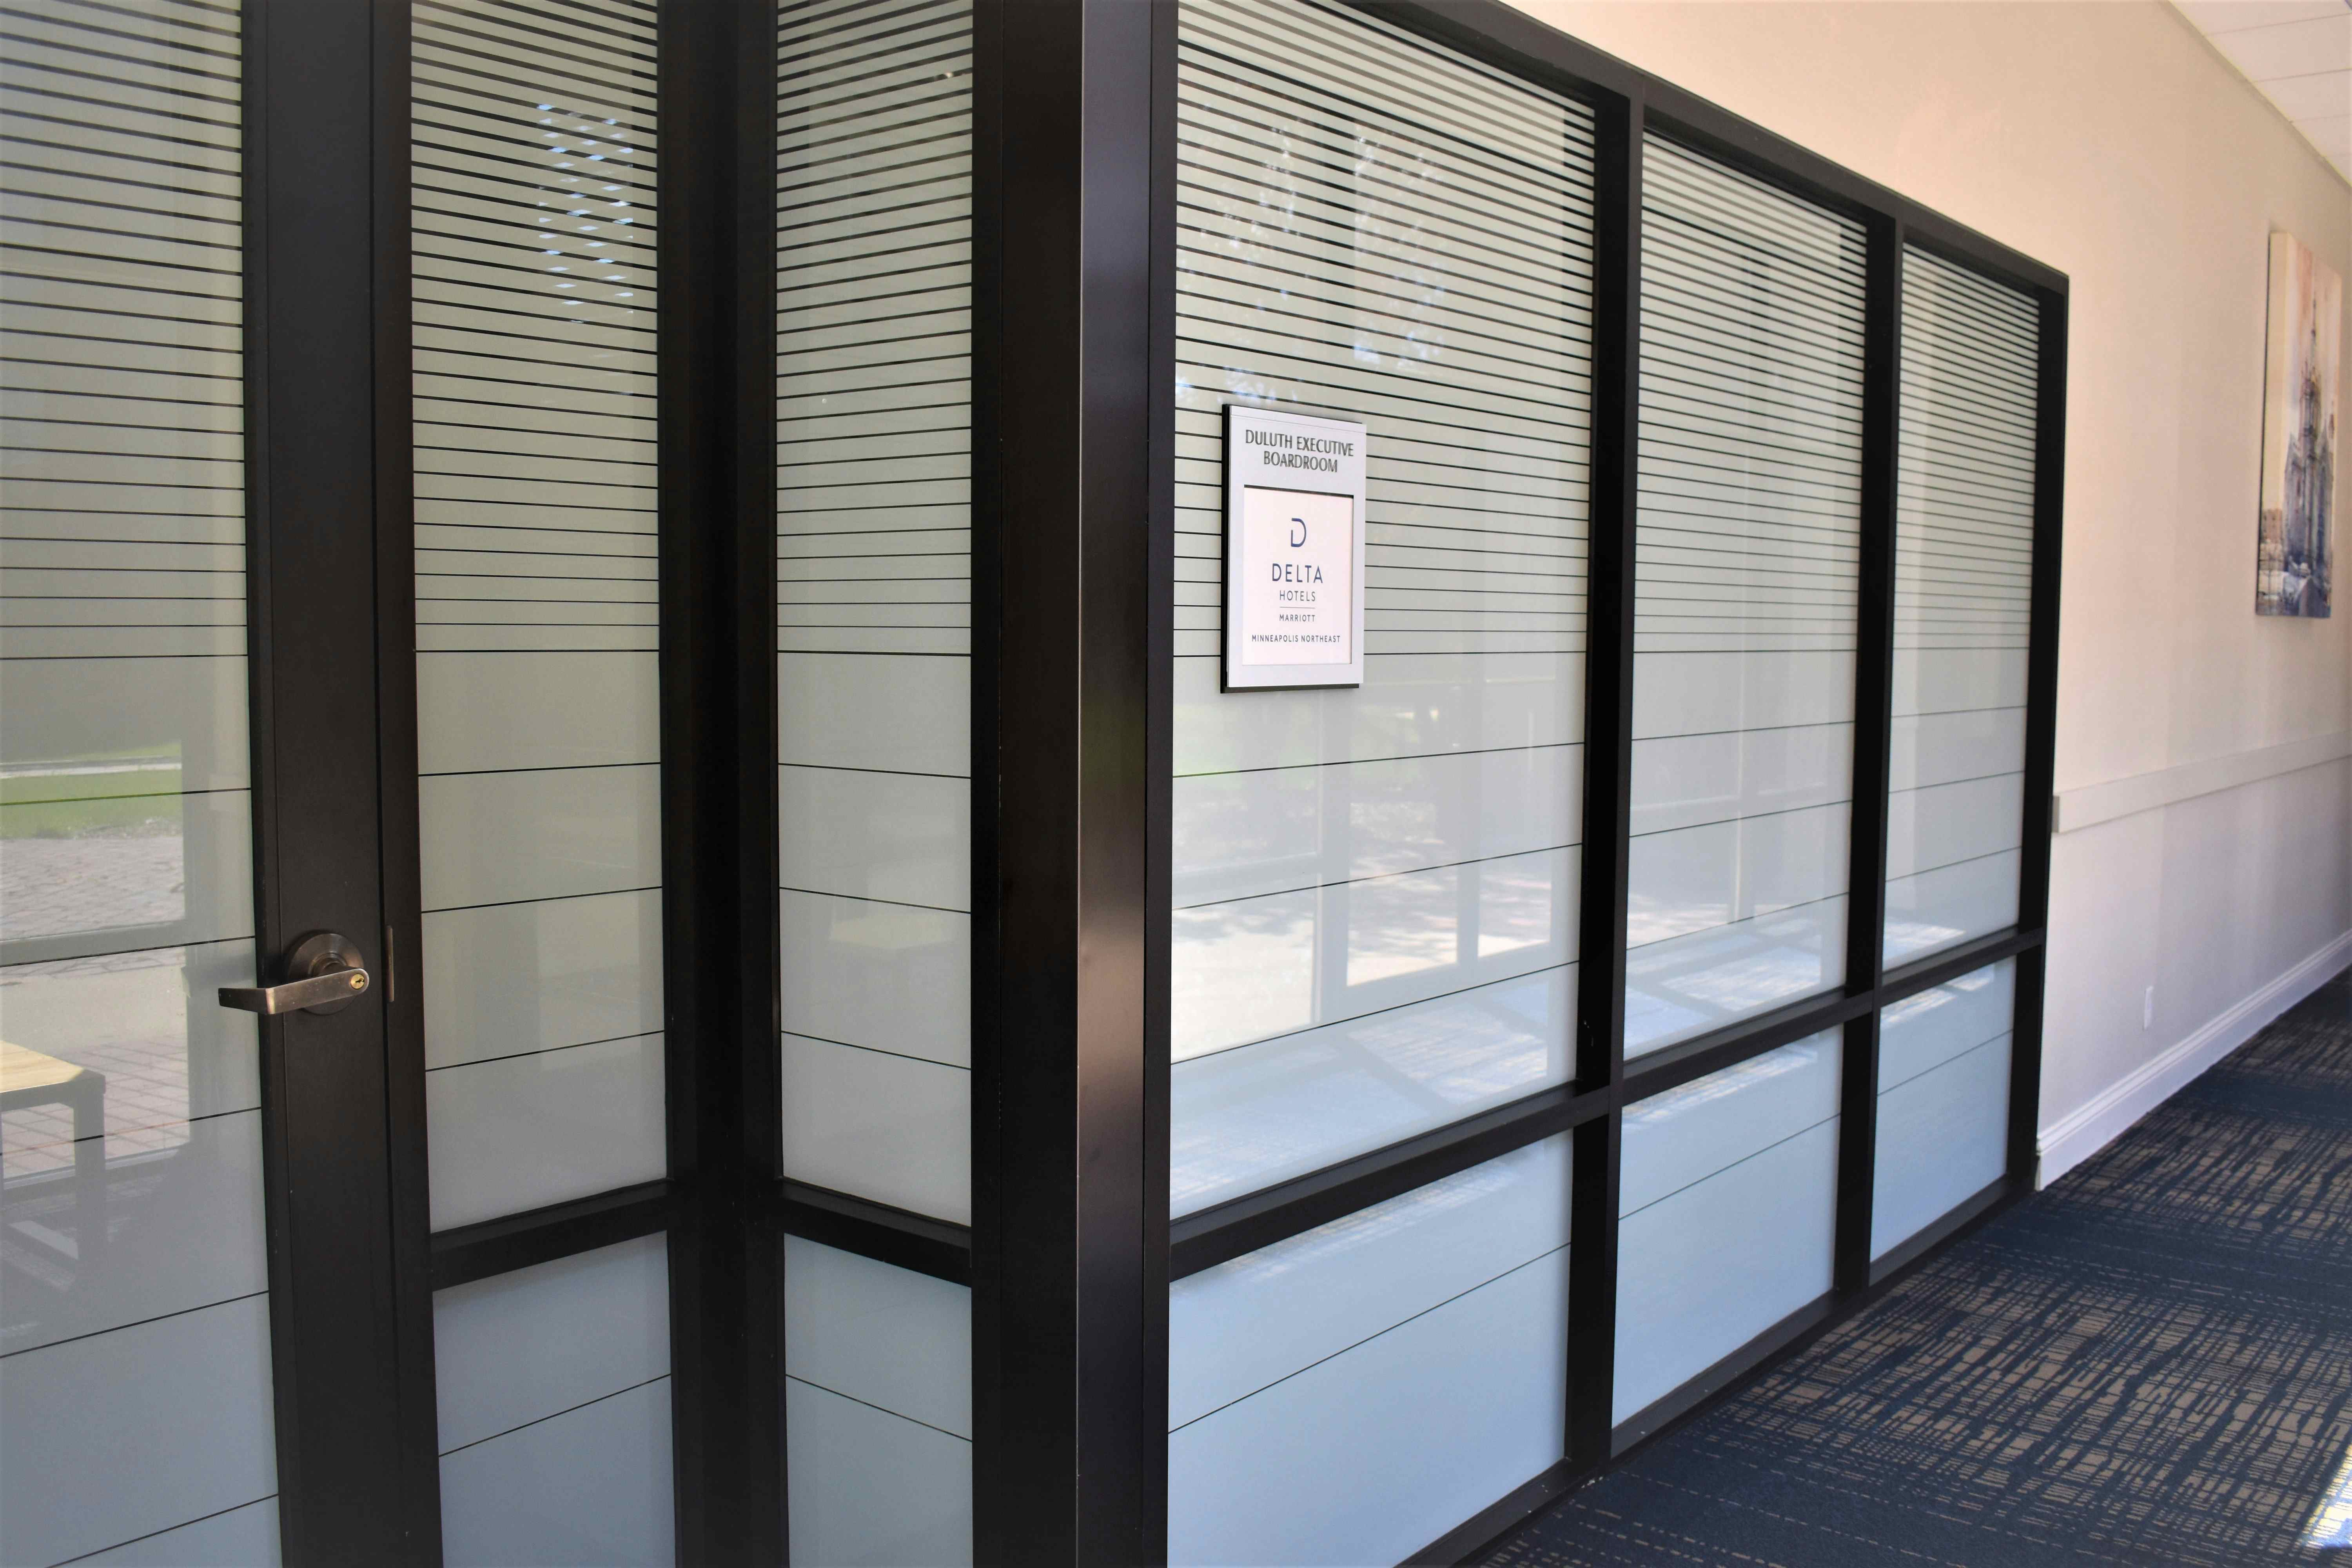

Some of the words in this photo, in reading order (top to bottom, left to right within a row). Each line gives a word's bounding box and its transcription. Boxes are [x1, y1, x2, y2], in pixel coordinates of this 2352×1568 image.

[1245, 429, 1293, 450] DULUTH
[1297, 436, 1354, 457] EXECUTIVE
[1263, 450, 1338, 473] BOARDROOM
[1272, 563, 1323, 584] DELTA
[1279, 590, 1316, 602] HOTELS
[1279, 614, 1315, 622] MARRIOTT
[1252, 634, 1299, 642] MINNEAPOLIS
